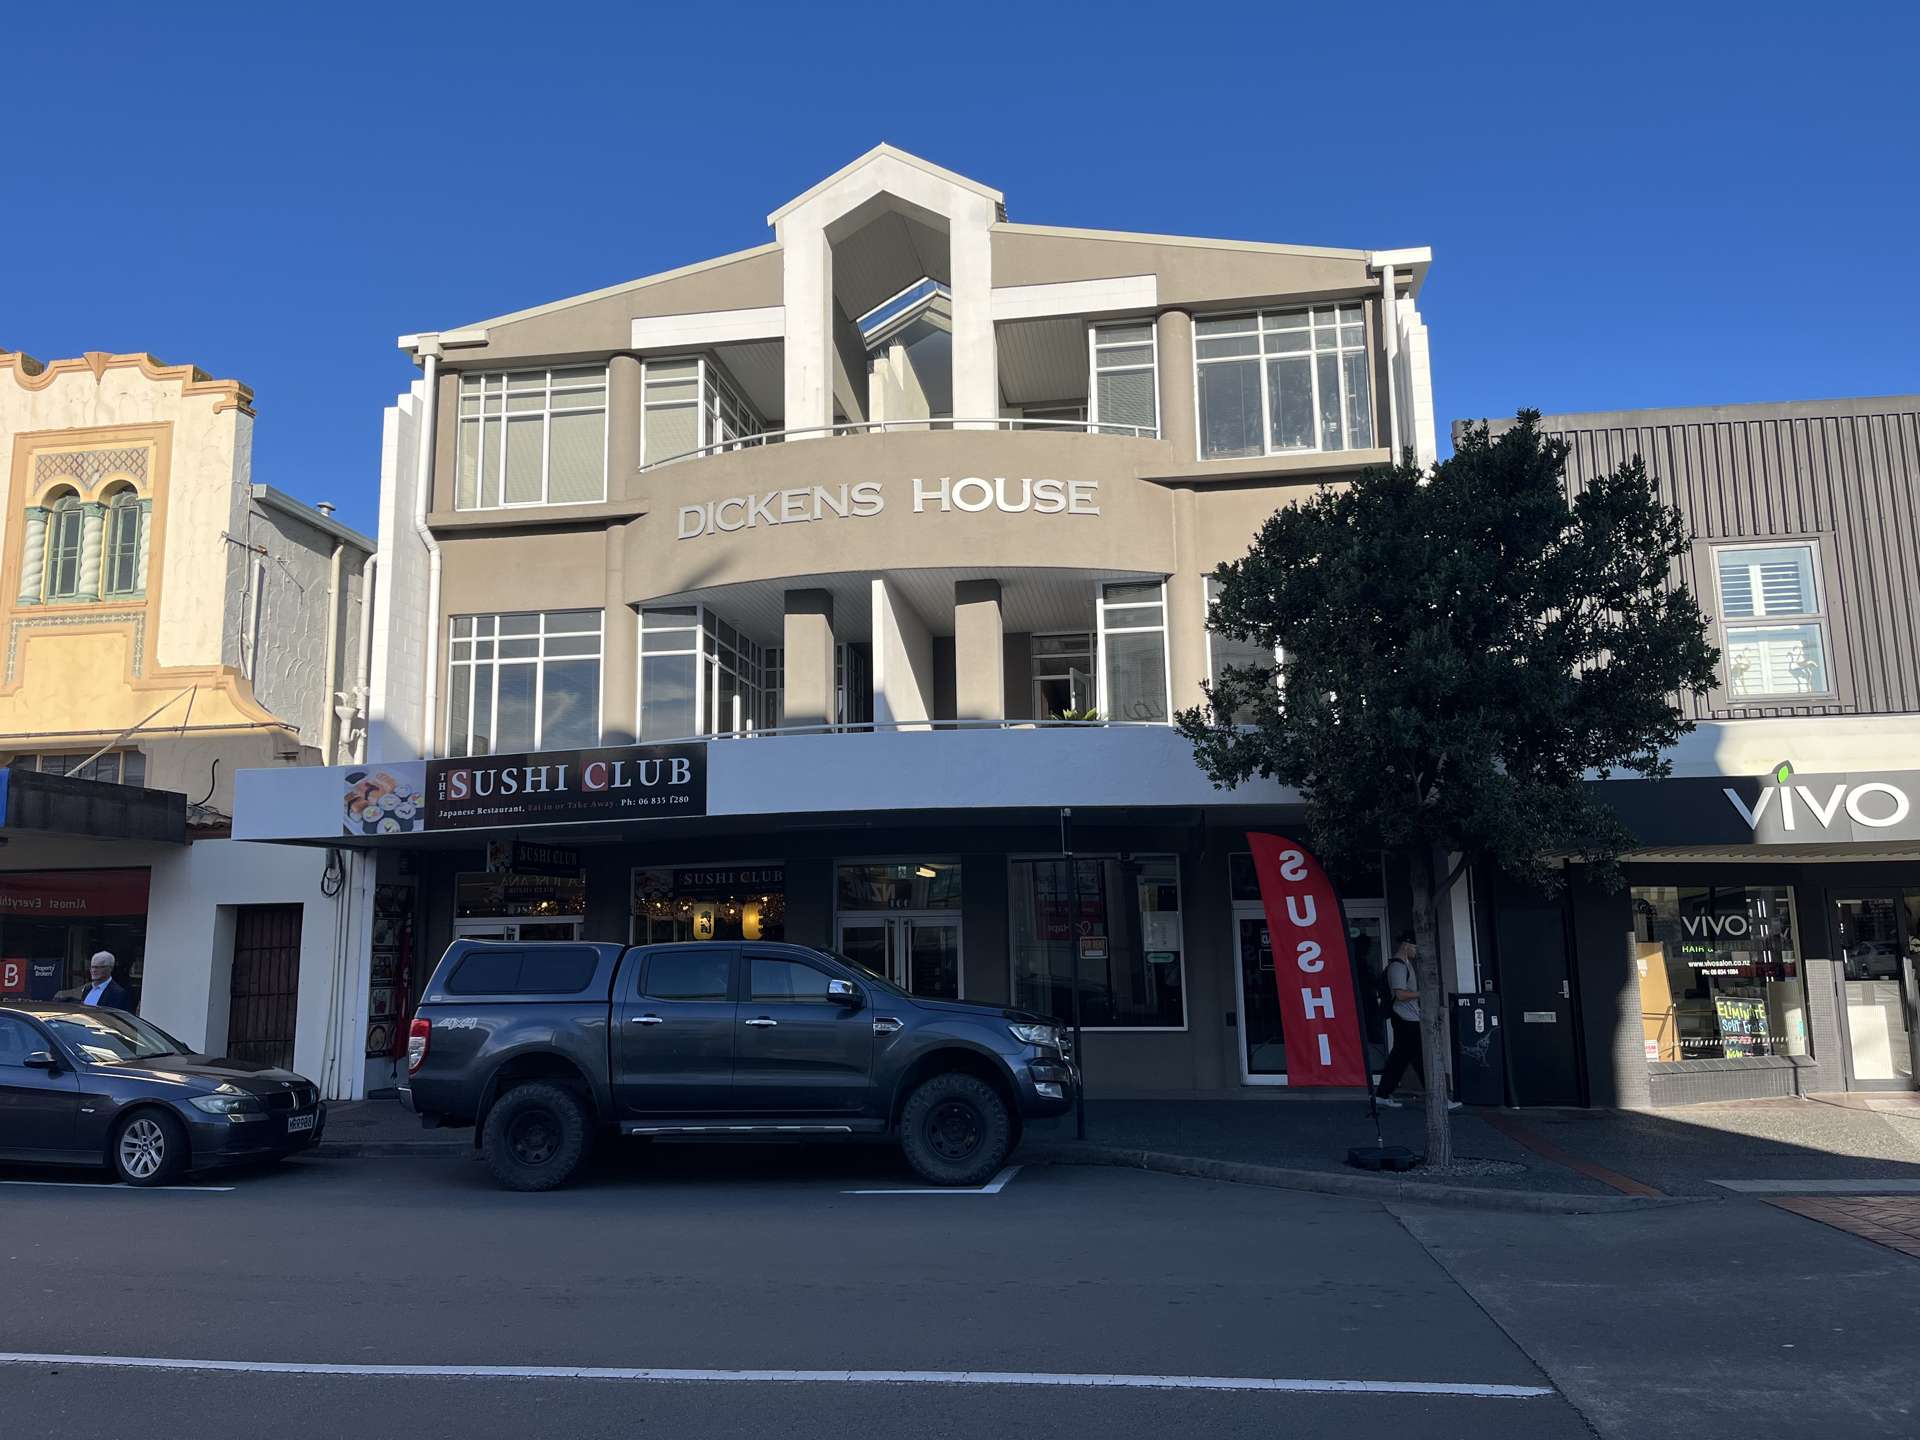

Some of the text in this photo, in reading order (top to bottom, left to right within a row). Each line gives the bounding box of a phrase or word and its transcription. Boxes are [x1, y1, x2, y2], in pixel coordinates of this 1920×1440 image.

[678, 477, 1100, 540] DICKENS HOUSE
[451, 764, 568, 799] SUSHI
[584, 757, 691, 790] CLUB
[439, 808, 475, 819] Japanese
[621, 797, 636, 806] Ph:
[638, 797, 649, 805] 06
[684, 870, 783, 885] SUSHI CLUB
[1688, 960, 1750, 968] www.vivosalon.co.nz
